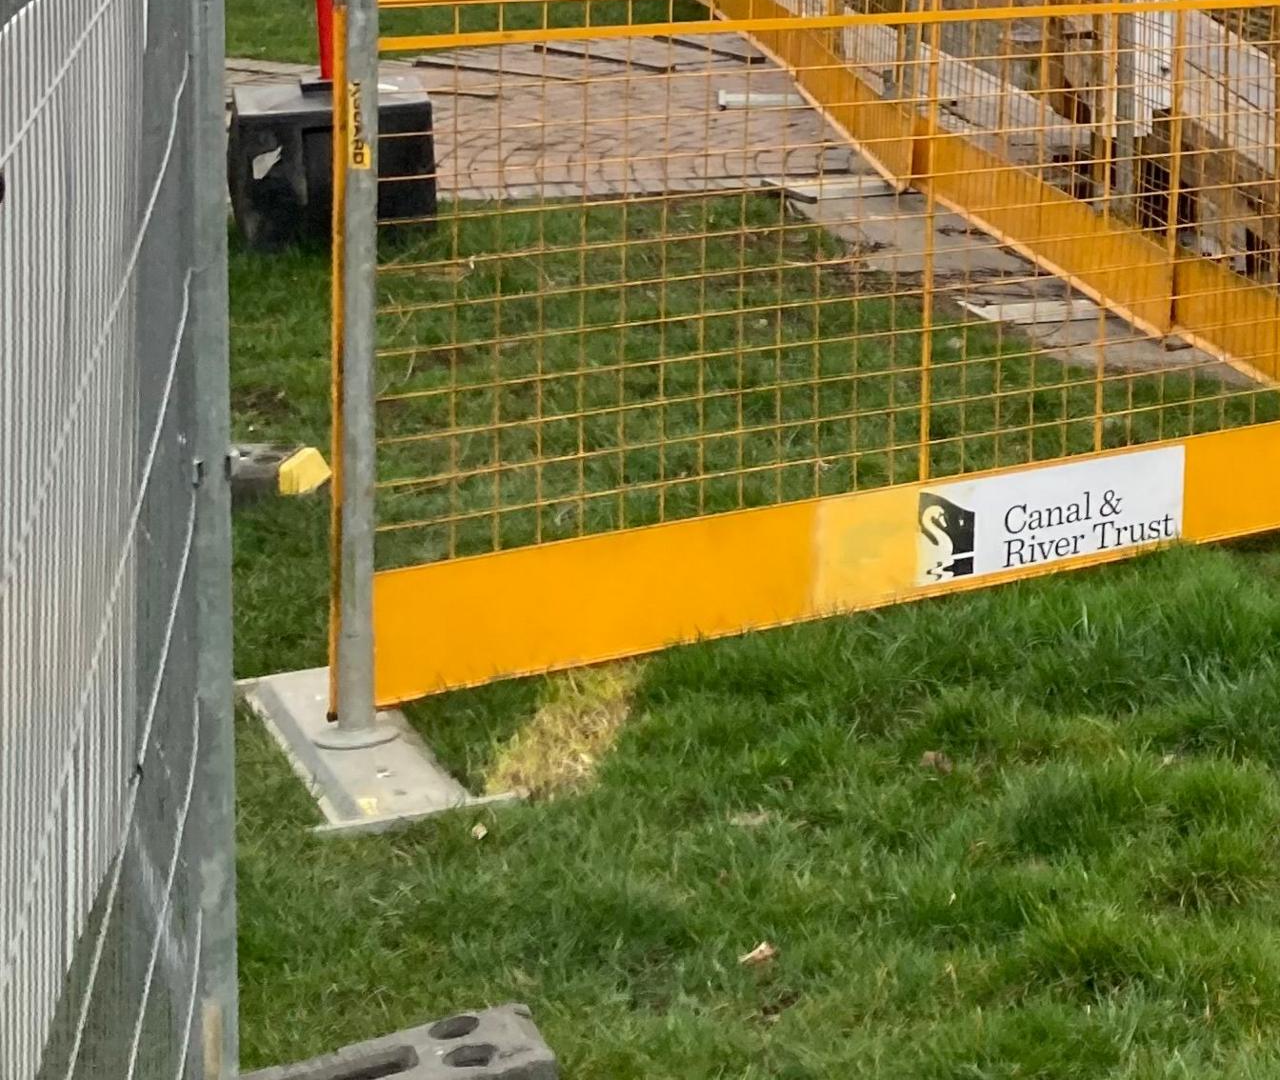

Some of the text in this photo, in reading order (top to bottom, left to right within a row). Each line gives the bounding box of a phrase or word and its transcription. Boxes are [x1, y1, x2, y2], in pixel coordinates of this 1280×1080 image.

[1004, 489, 1122, 534] Canal &
[1002, 513, 1174, 568] River Trust
